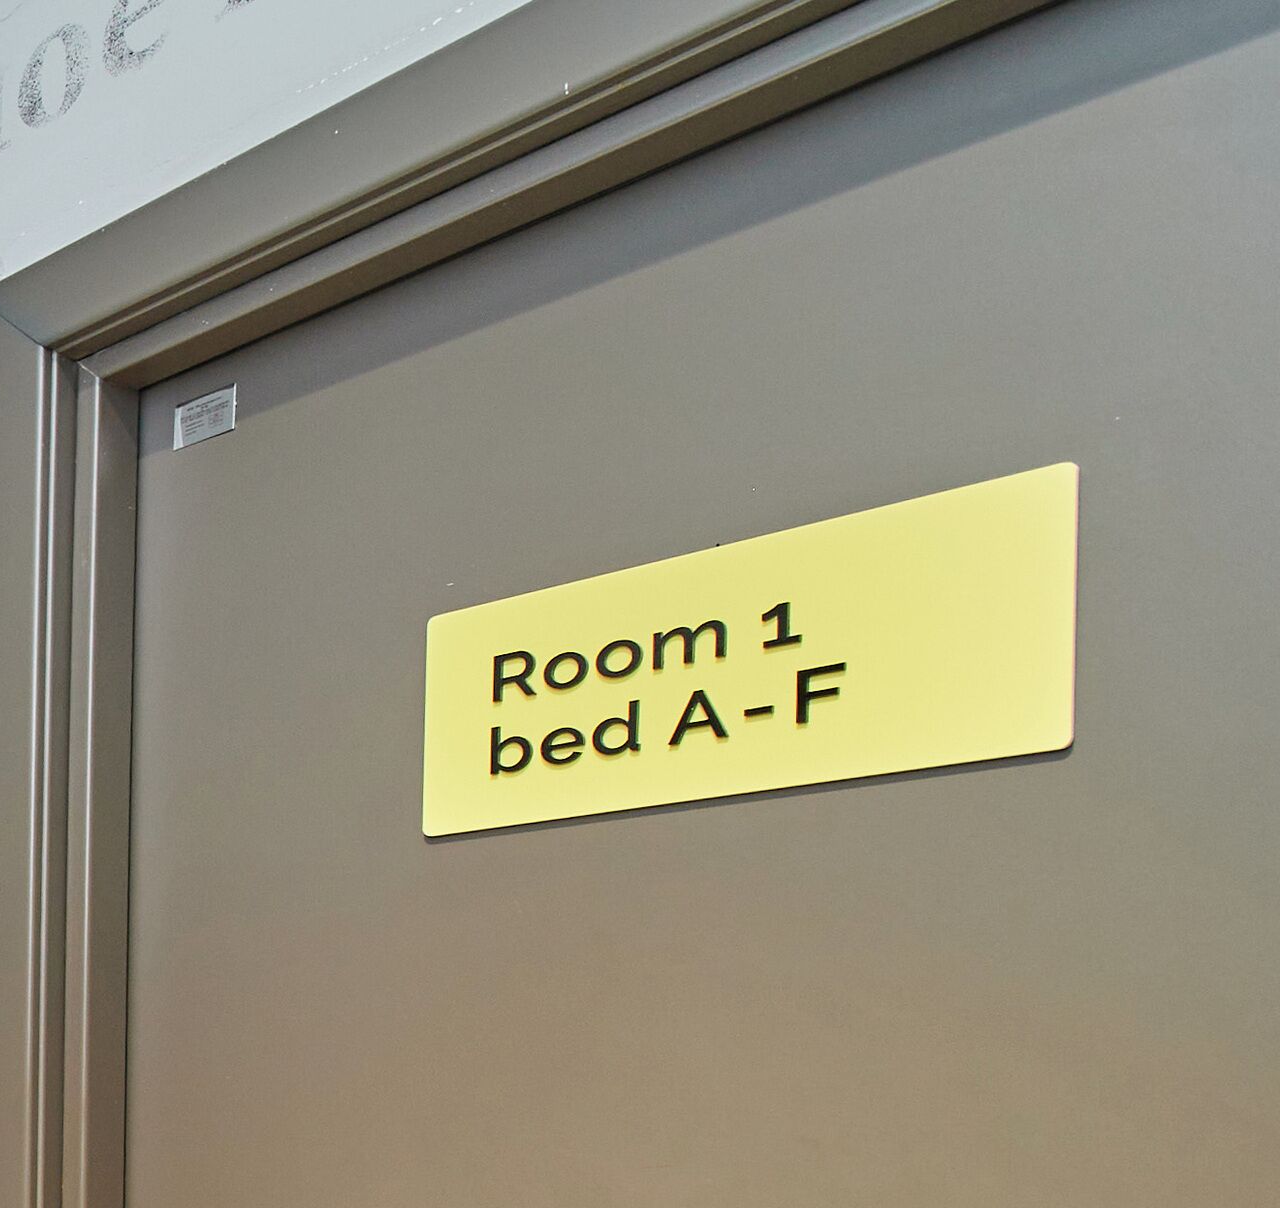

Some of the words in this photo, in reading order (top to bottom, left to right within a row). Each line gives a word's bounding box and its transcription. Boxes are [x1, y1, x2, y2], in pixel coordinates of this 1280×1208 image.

[490, 616, 729, 703] Room
[759, 600, 803, 650] 1
[488, 700, 641, 776] bed
